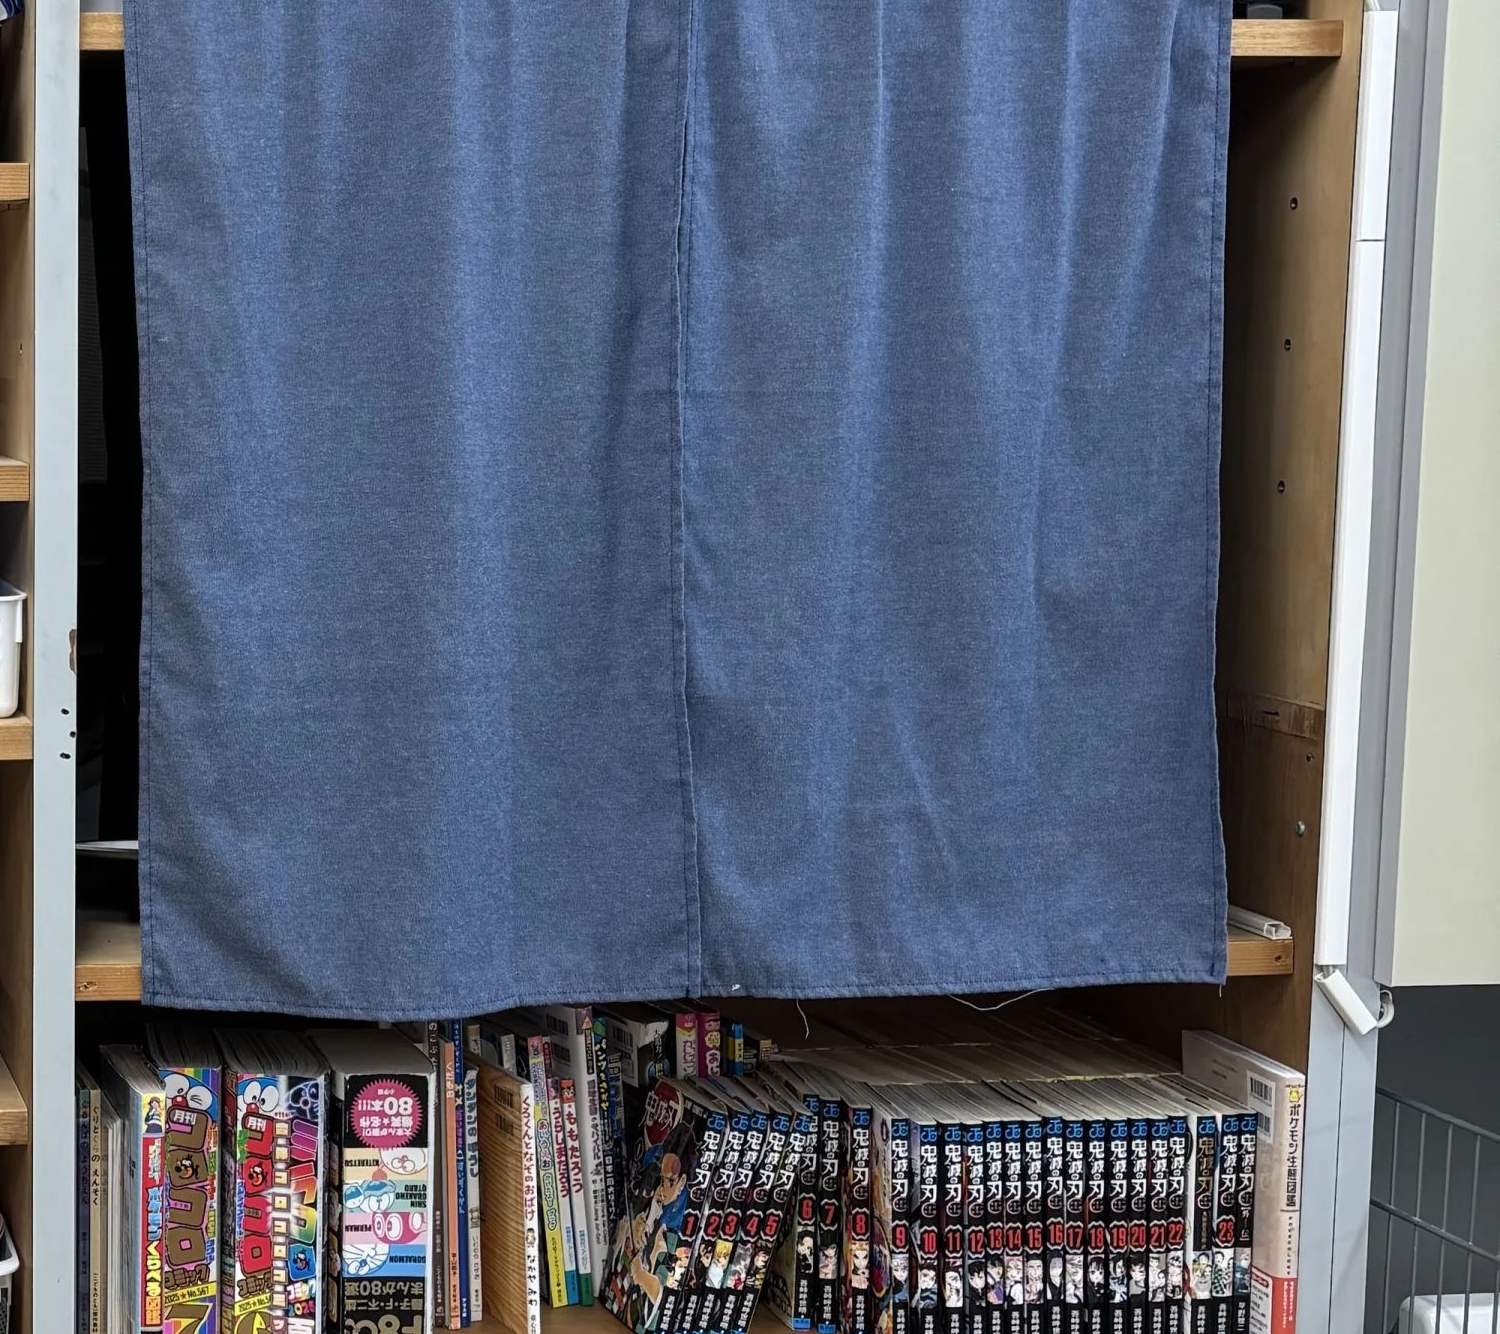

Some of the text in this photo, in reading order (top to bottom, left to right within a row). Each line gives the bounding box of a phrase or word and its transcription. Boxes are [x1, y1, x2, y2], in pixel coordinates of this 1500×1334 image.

[172, 1109, 197, 1125] 月刊
[247, 1117, 267, 1132] 月刊
[522, 1096, 536, 1222] くろくんとなぞのおばけ
[552, 1106, 569, 1198] うらしまたろう
[565, 1111, 583, 1194] ももたろう
[732, 1130, 764, 1188] 鬼滅の刃
[822, 1120, 839, 1177] 鬼滅の刃
[852, 1128, 870, 1185] 鬼滅の刃
[688, 1131, 720, 1189] 鬼滅の刃
[713, 1131, 745, 1189] 鬼滅の刃
[753, 1132, 786, 1190] 鬼滅の刃
[774, 1132, 806, 1189] 鬼滅の刃
[891, 1139, 909, 1198] 鬼滅の刃
[985, 1141, 1002, 1200] 鬼滅の刃
[1005, 1141, 1022, 1200] 鬼滅の刃
[1024, 1141, 1042, 1200] 鬼滅の刃
[1046, 1136, 1063, 1195] 鬼滅の刃
[1066, 1140, 1083, 1200] 鬼滅の刃
[1087, 1140, 1104, 1199] 鬼滅の刃
[1109, 1140, 1127, 1199] 鬼滅の刃
[1130, 1140, 1148, 1198] 鬼滅の刃
[1151, 1139, 1168, 1198] 鬼滅の刃
[1168, 1136, 1185, 1195] 鬼滅の刃
[1218, 1134, 1238, 1193] 鬼滅の刃
[1237, 1133, 1256, 1193] 鬼滅の刃
[920, 1144, 937, 1204] 鬼滅の刃
[944, 1143, 962, 1202] 鬼滅の刃
[966, 1145, 984, 1203] 鬼滅の刃
[802, 1198, 812, 1215] 6
[825, 1205, 835, 1224] 7
[344, 1224, 372, 1233] PERMAN
[707, 1217, 719, 1235] 2
[724, 1217, 736, 1234] 3
[746, 1217, 758, 1235] 4
[765, 1217, 778, 1234] 5
[856, 1214, 866, 1233] 8
[1049, 1223, 1063, 1244] 16
[1168, 1223, 1183, 1243] 22
[1218, 1222, 1234, 1241] 23
[896, 1226, 906, 1246] 9
[923, 1232, 937, 1252] 10
[947, 1231, 961, 1251] 11
[969, 1232, 984, 1252] 12
[988, 1228, 1002, 1248] 13
[1007, 1228, 1022, 1248] 14
[1028, 1228, 1042, 1248] 15
[1067, 1228, 1082, 1247] 17
[1090, 1227, 1103, 1246] 18
[1112, 1227, 1126, 1246] 19
[1131, 1226, 1146, 1245] 20
[1151, 1226, 1166, 1246] 21
[165, 1268, 211, 1290] コミック
[345, 1280, 424, 1296] まんが80選
